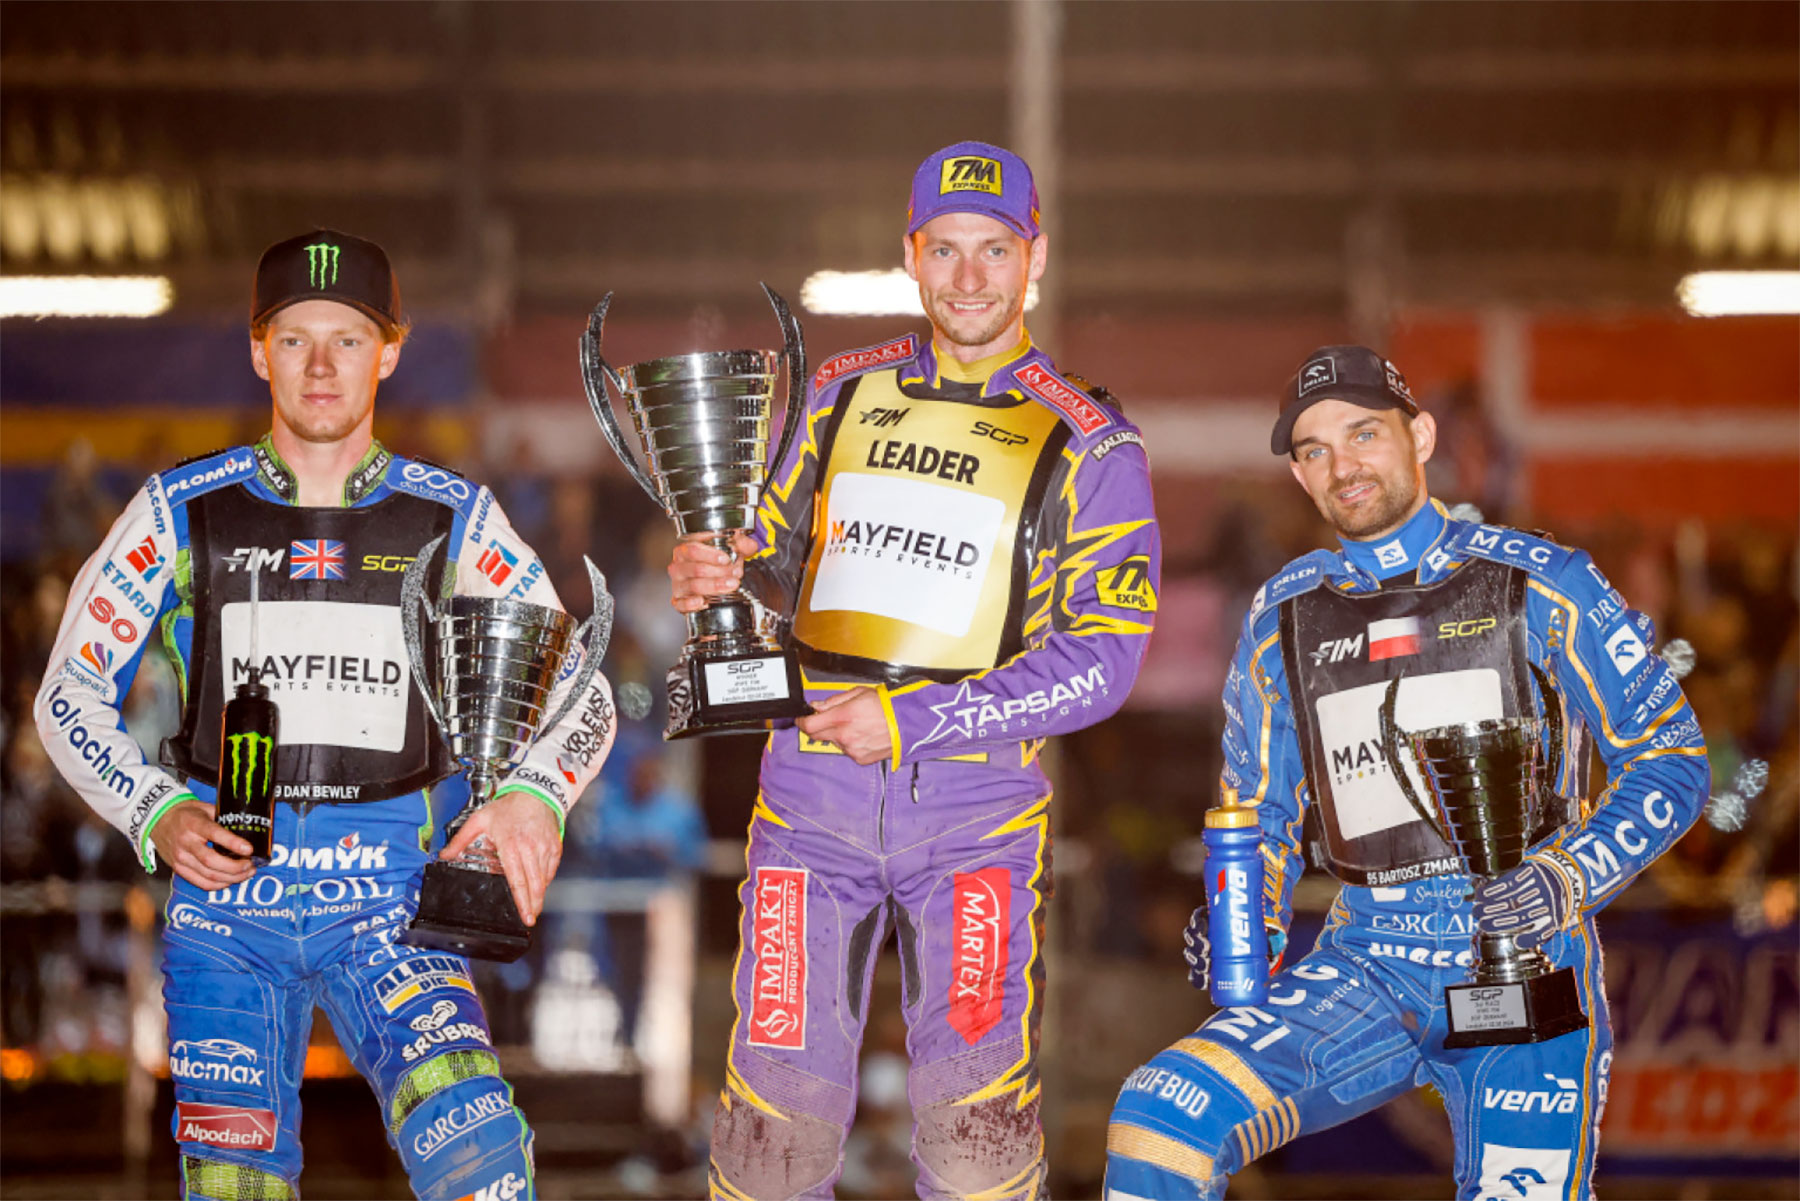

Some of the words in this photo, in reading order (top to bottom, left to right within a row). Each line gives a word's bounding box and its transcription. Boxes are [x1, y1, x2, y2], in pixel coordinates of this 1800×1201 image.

[948, 160, 995, 183] TM
[1042, 379, 1102, 422] IMPAKT
[859, 407, 911, 427] FIM
[970, 421, 1029, 445] SGP
[866, 439, 980, 485] LEADER
[831, 520, 980, 567] MAYFIELD
[896, 553, 972, 579] EVENTS
[1271, 566, 1317, 590] ORLEN
[1438, 618, 1496, 639] SGP
[1308, 633, 1364, 667] FIM
[232, 655, 401, 685] MAYFIELD
[727, 661, 764, 675] SGP
[326, 681, 400, 697] EVENTS
[954, 665, 1107, 730] TAPSAM
[978, 686, 1109, 738] DESIGNS
[284, 785, 309, 798] DAN
[313, 786, 360, 799] BEWLEY
[1379, 864, 1420, 884] BARTOSZ
[1423, 857, 1460, 875] ZMAR
[789, 880, 798, 927] ZNICZY
[1227, 868, 1252, 956] verva
[758, 878, 784, 1002] IMPAKT
[957, 891, 987, 999] MARTEX
[1470, 988, 1504, 1001] SGP
[1484, 1087, 1579, 1114] verva
[183, 1122, 263, 1145] Alpodach
[414, 1091, 512, 1157] GARCAREK
